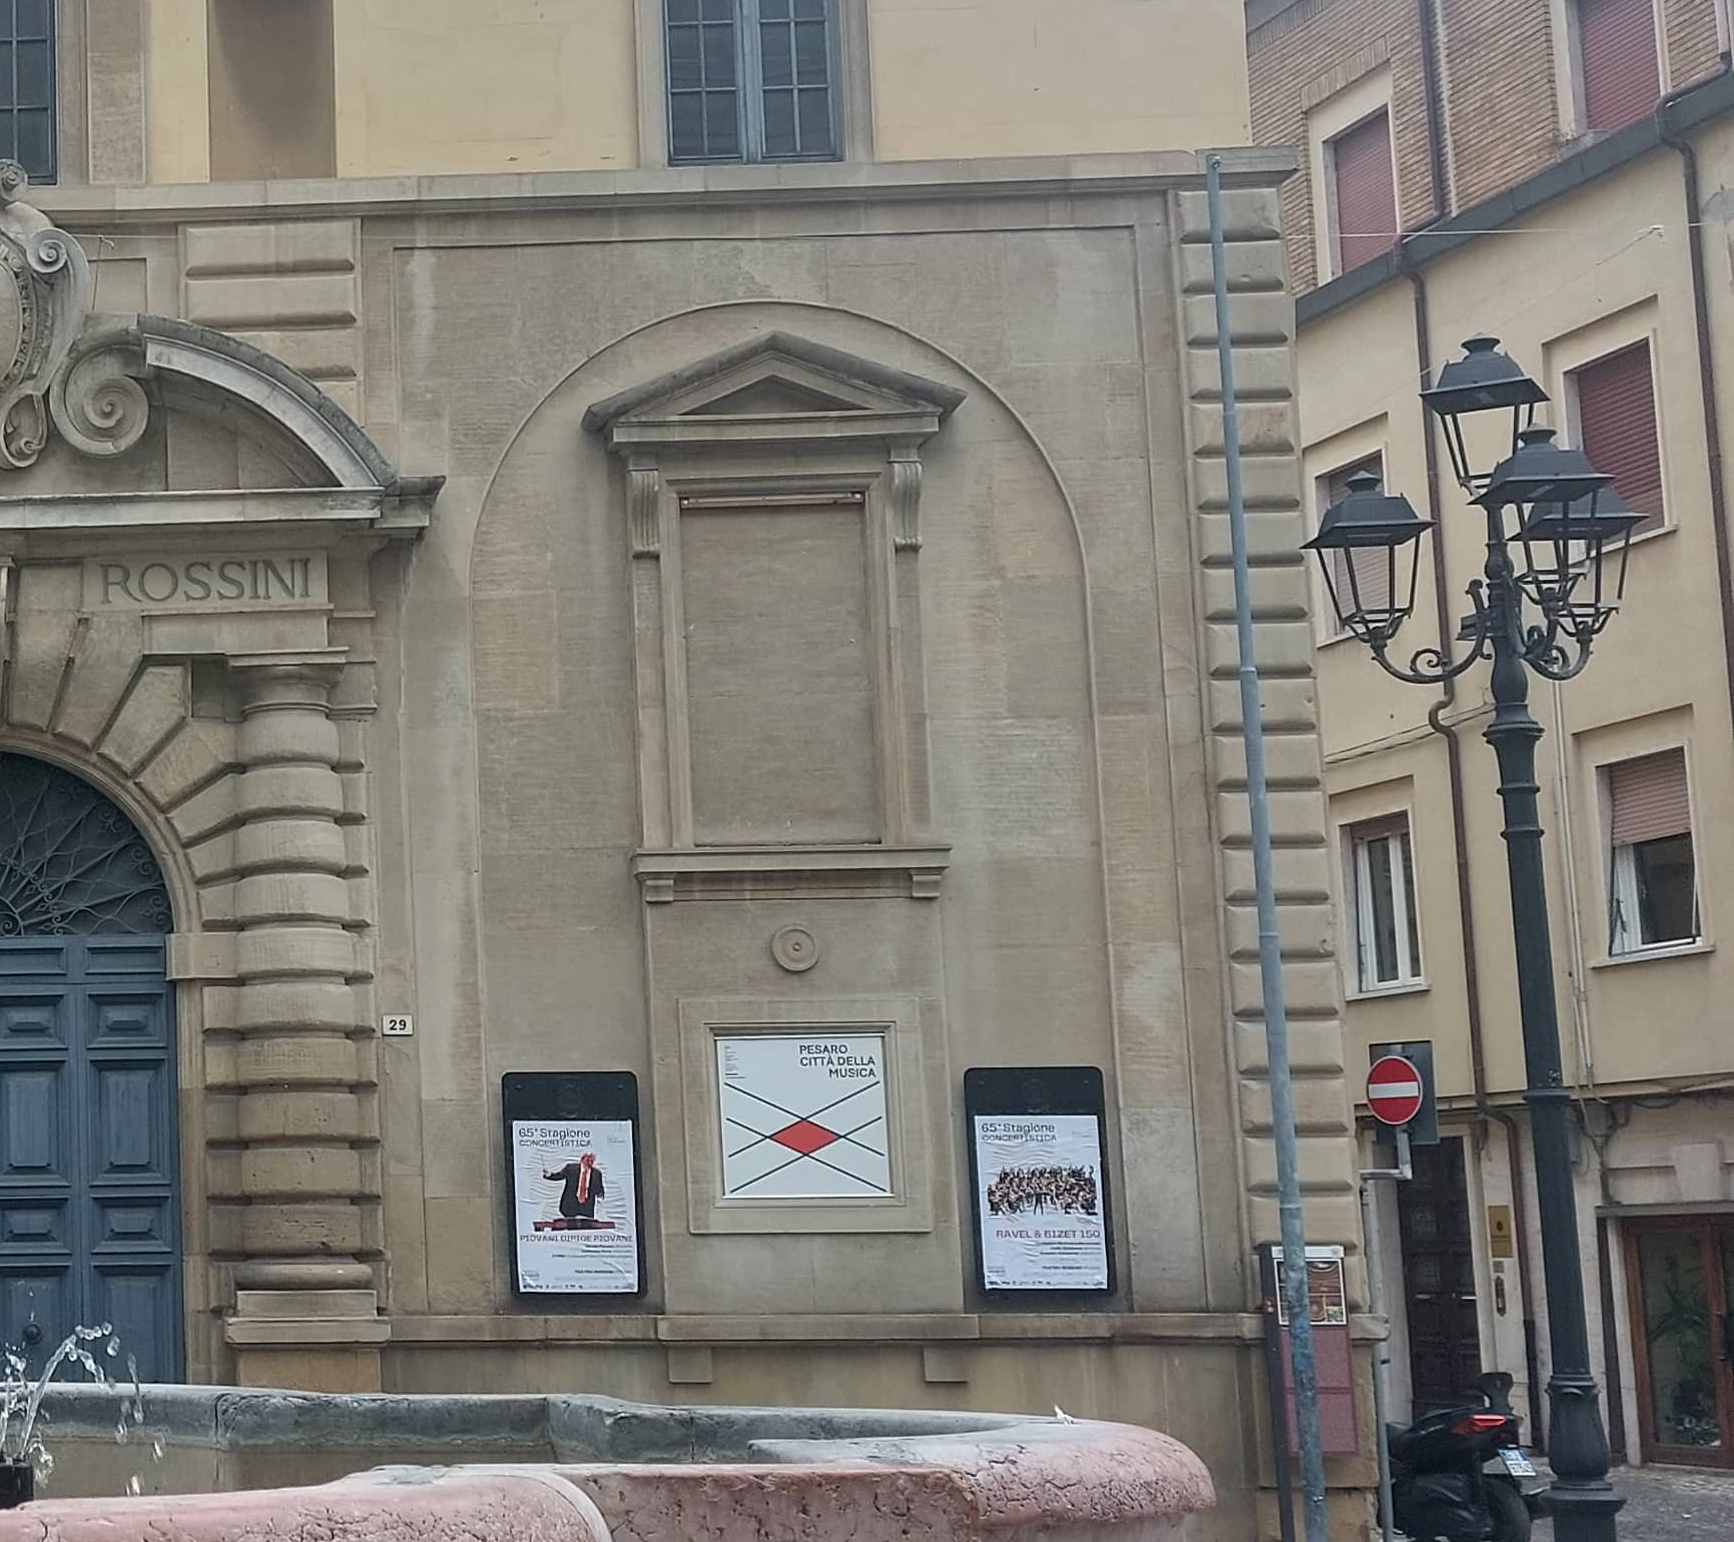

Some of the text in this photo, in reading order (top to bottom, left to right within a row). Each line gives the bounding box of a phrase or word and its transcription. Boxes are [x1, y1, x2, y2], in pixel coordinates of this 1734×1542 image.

[99, 556, 312, 604] ROSSINI
[389, 1019, 407, 1031] 29
[799, 1044, 848, 1055] PESARO
[799, 1054, 876, 1067] CITTÀ DELLA
[829, 1067, 877, 1078] MUSICA
[539, 1127, 591, 1140] Stagione
[1002, 1122, 1056, 1135] Stagione
[518, 1139, 591, 1147] CONCERTISTICA
[981, 1134, 1058, 1142] CONCERTISTICA
[593, 1234, 634, 1242] PIOVANI
[996, 1229, 1101, 1239] RAVEL & BIZET 150
